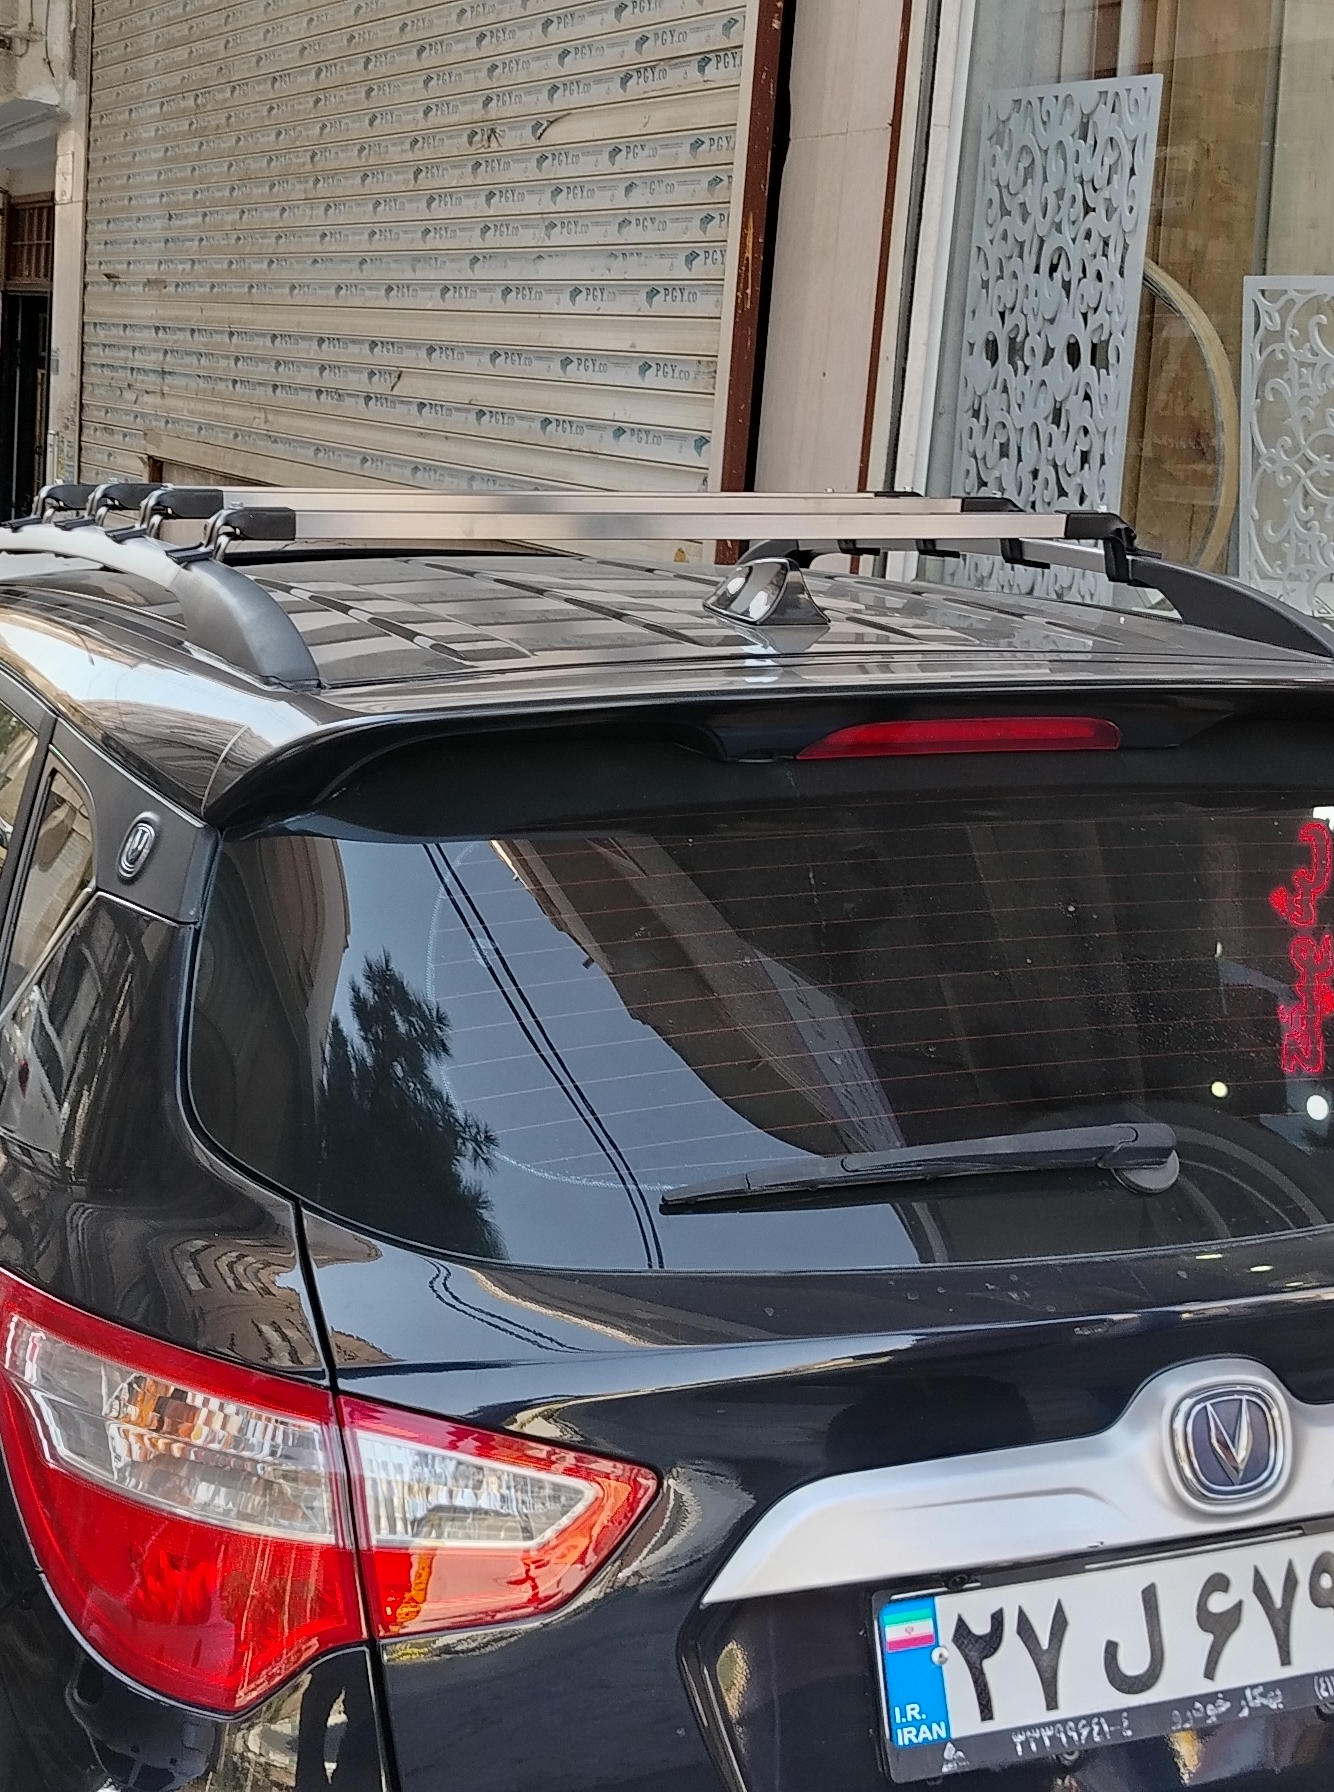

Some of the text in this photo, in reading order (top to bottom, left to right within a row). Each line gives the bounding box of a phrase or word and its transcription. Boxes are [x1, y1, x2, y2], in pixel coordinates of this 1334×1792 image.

[502, 59, 531, 75] PGY.co
[653, 30, 688, 47] PGY.co
[495, 93, 523, 108] PGY.co
[562, 81, 592, 97] PGY.co
[636, 67, 667, 85] PGY.co
[485, 157, 511, 172] PGY.co
[551, 154, 580, 168] PGY.co
[709, 136, 736, 151] PGY.
[499, 190, 526, 204] PGY.co
[566, 185, 595, 200] PGY.co
[493, 223, 519, 237] PGY.co
[560, 220, 589, 234] PGY.co
[516, 287, 543, 301] PGY.co
[663, 287, 698, 302] PGY.co
[504, 351, 533, 367] PGY.co
[577, 358, 608, 374] PGY.co
[655, 361, 690, 381] PGY.co
[555, 419, 585, 436] PGY.co
[629, 428, 662, 446] PGY.co
[951, 1599, 1070, 1723] ۲۷
[1104, 1582, 1165, 1696] ل
[894, 1703, 927, 1725] I.R.
[1170, 1692, 1231, 1731] خودرو
[896, 1721, 947, 1746] IRAN
